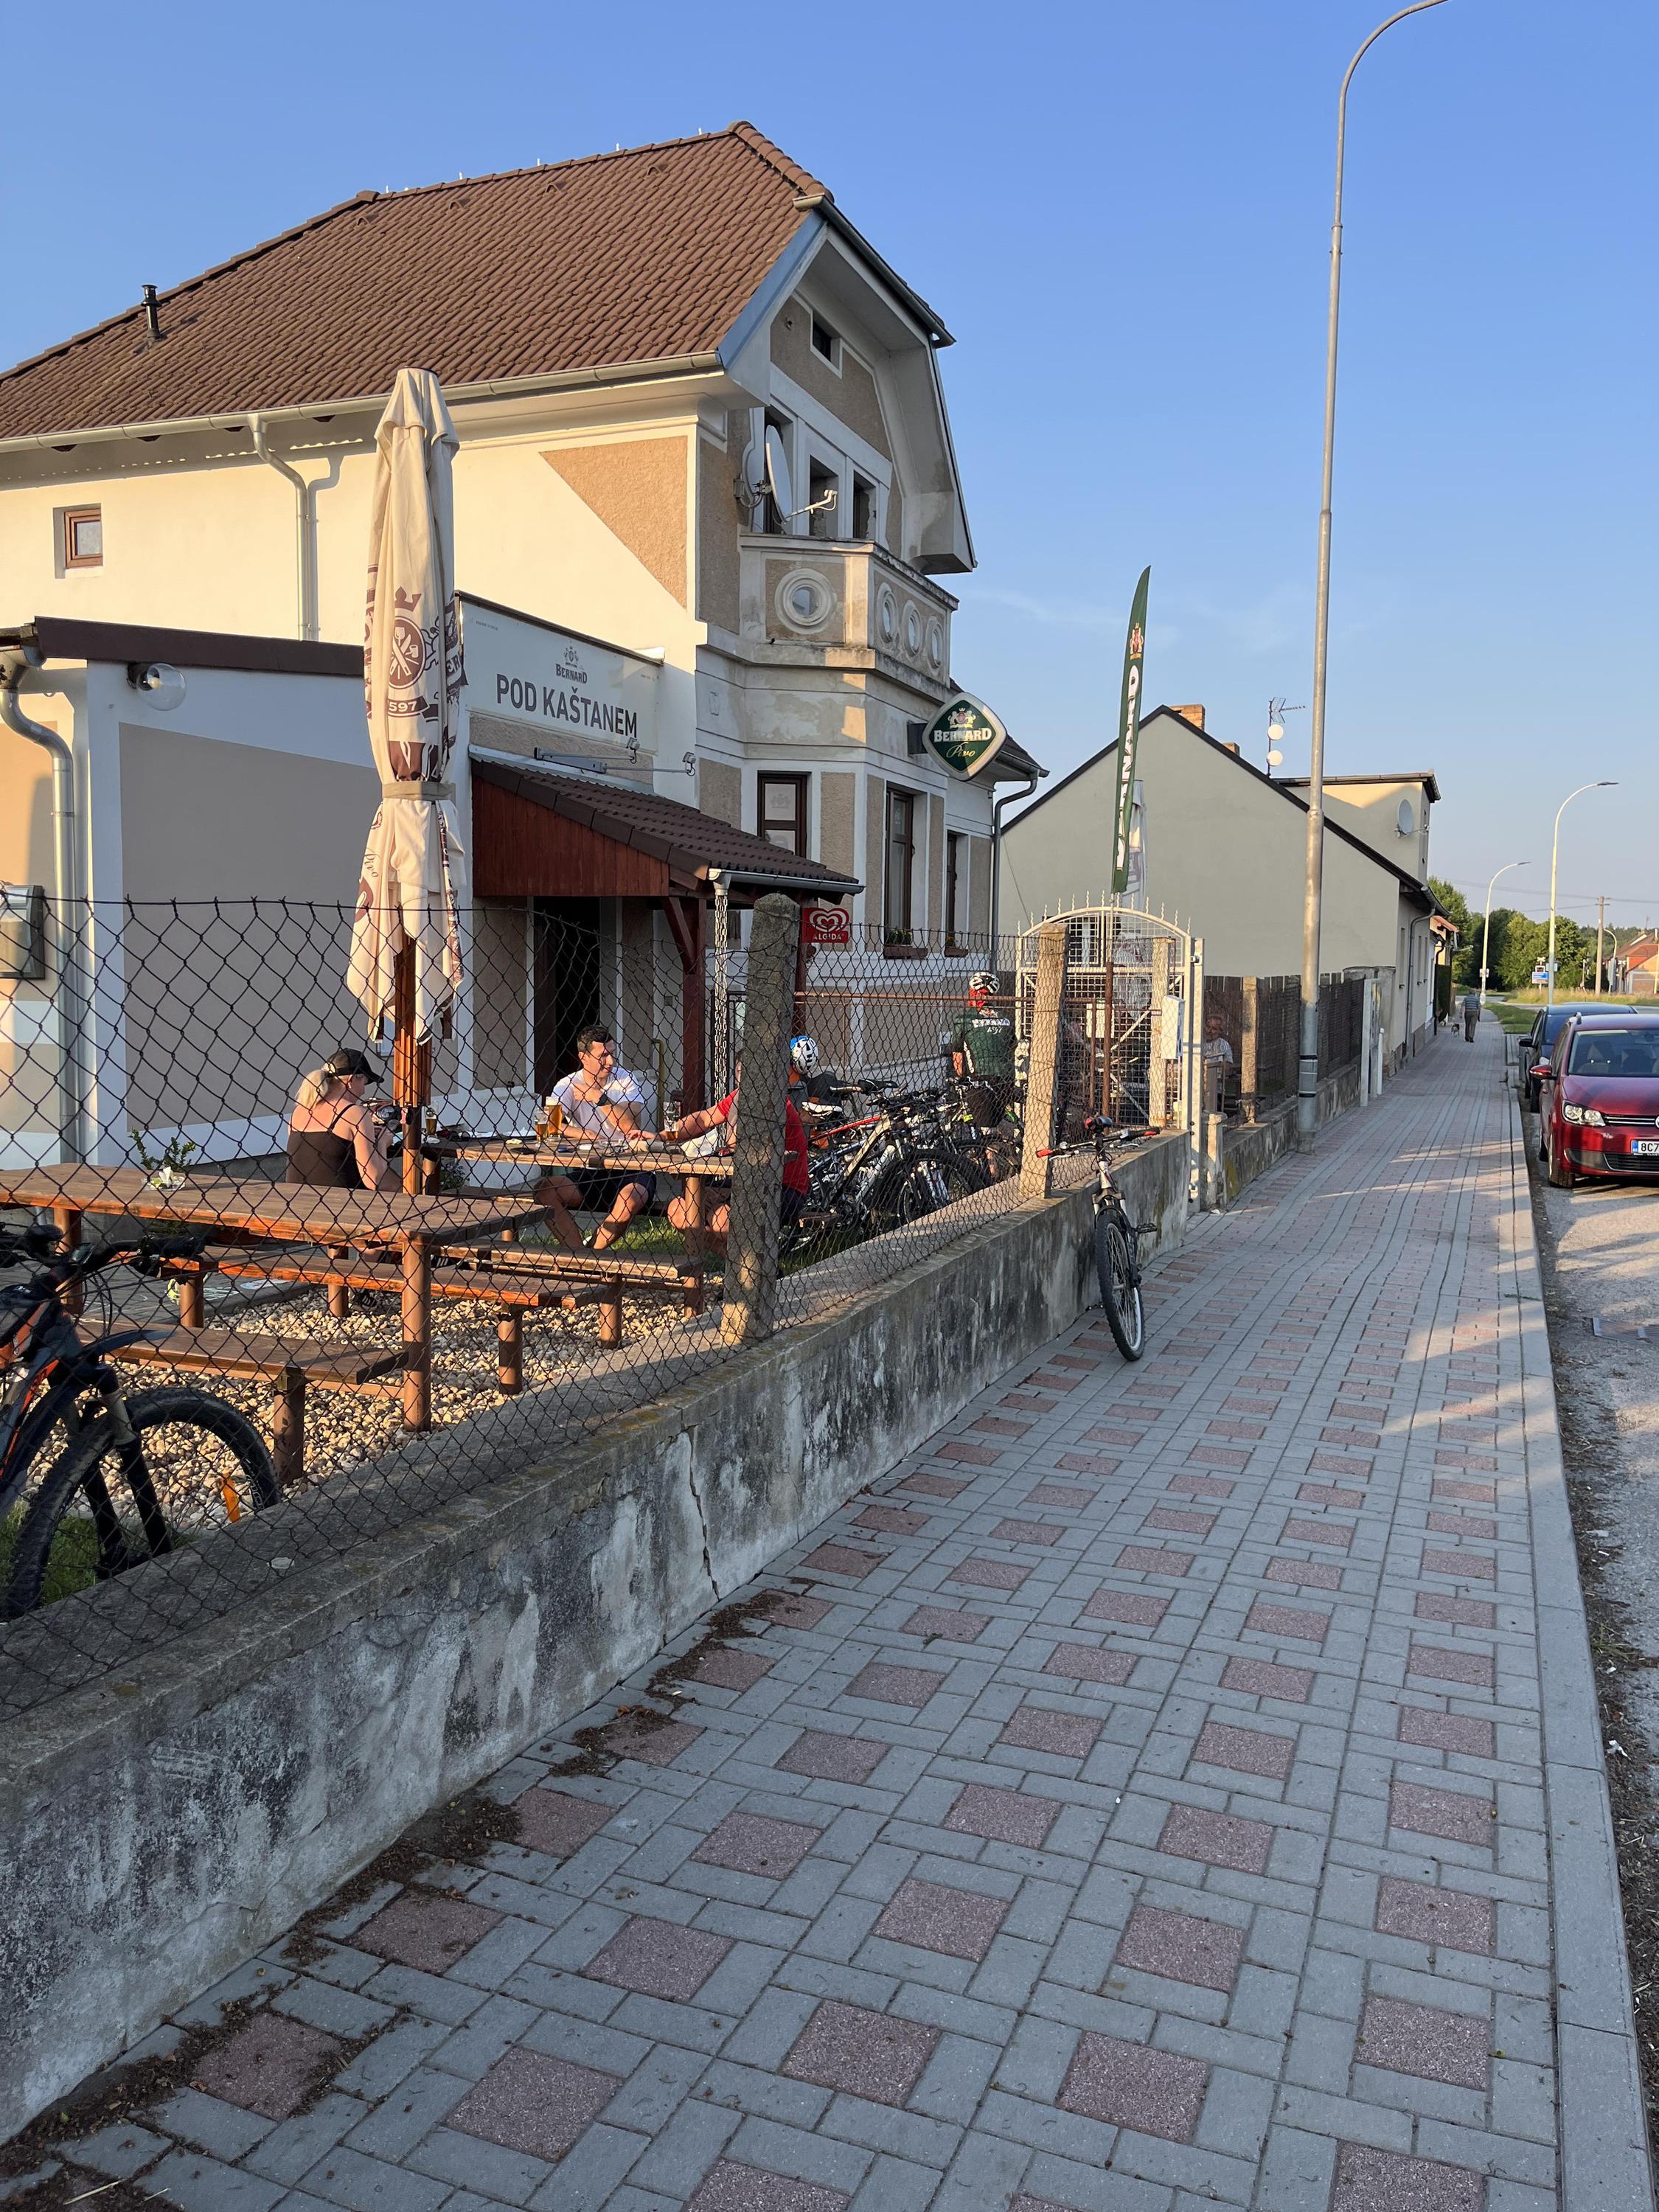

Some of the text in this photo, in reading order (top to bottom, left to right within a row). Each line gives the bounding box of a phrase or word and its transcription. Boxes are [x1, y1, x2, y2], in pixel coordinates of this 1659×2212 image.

[555, 663, 588, 684] BERNARD
[388, 700, 417, 712] 597
[496, 673, 638, 738] POD KAŠTANEM
[933, 727, 992, 742] BERNARD
[945, 742, 976, 759] Pivo
[1641, 1142, 1659, 1152] 8C7
